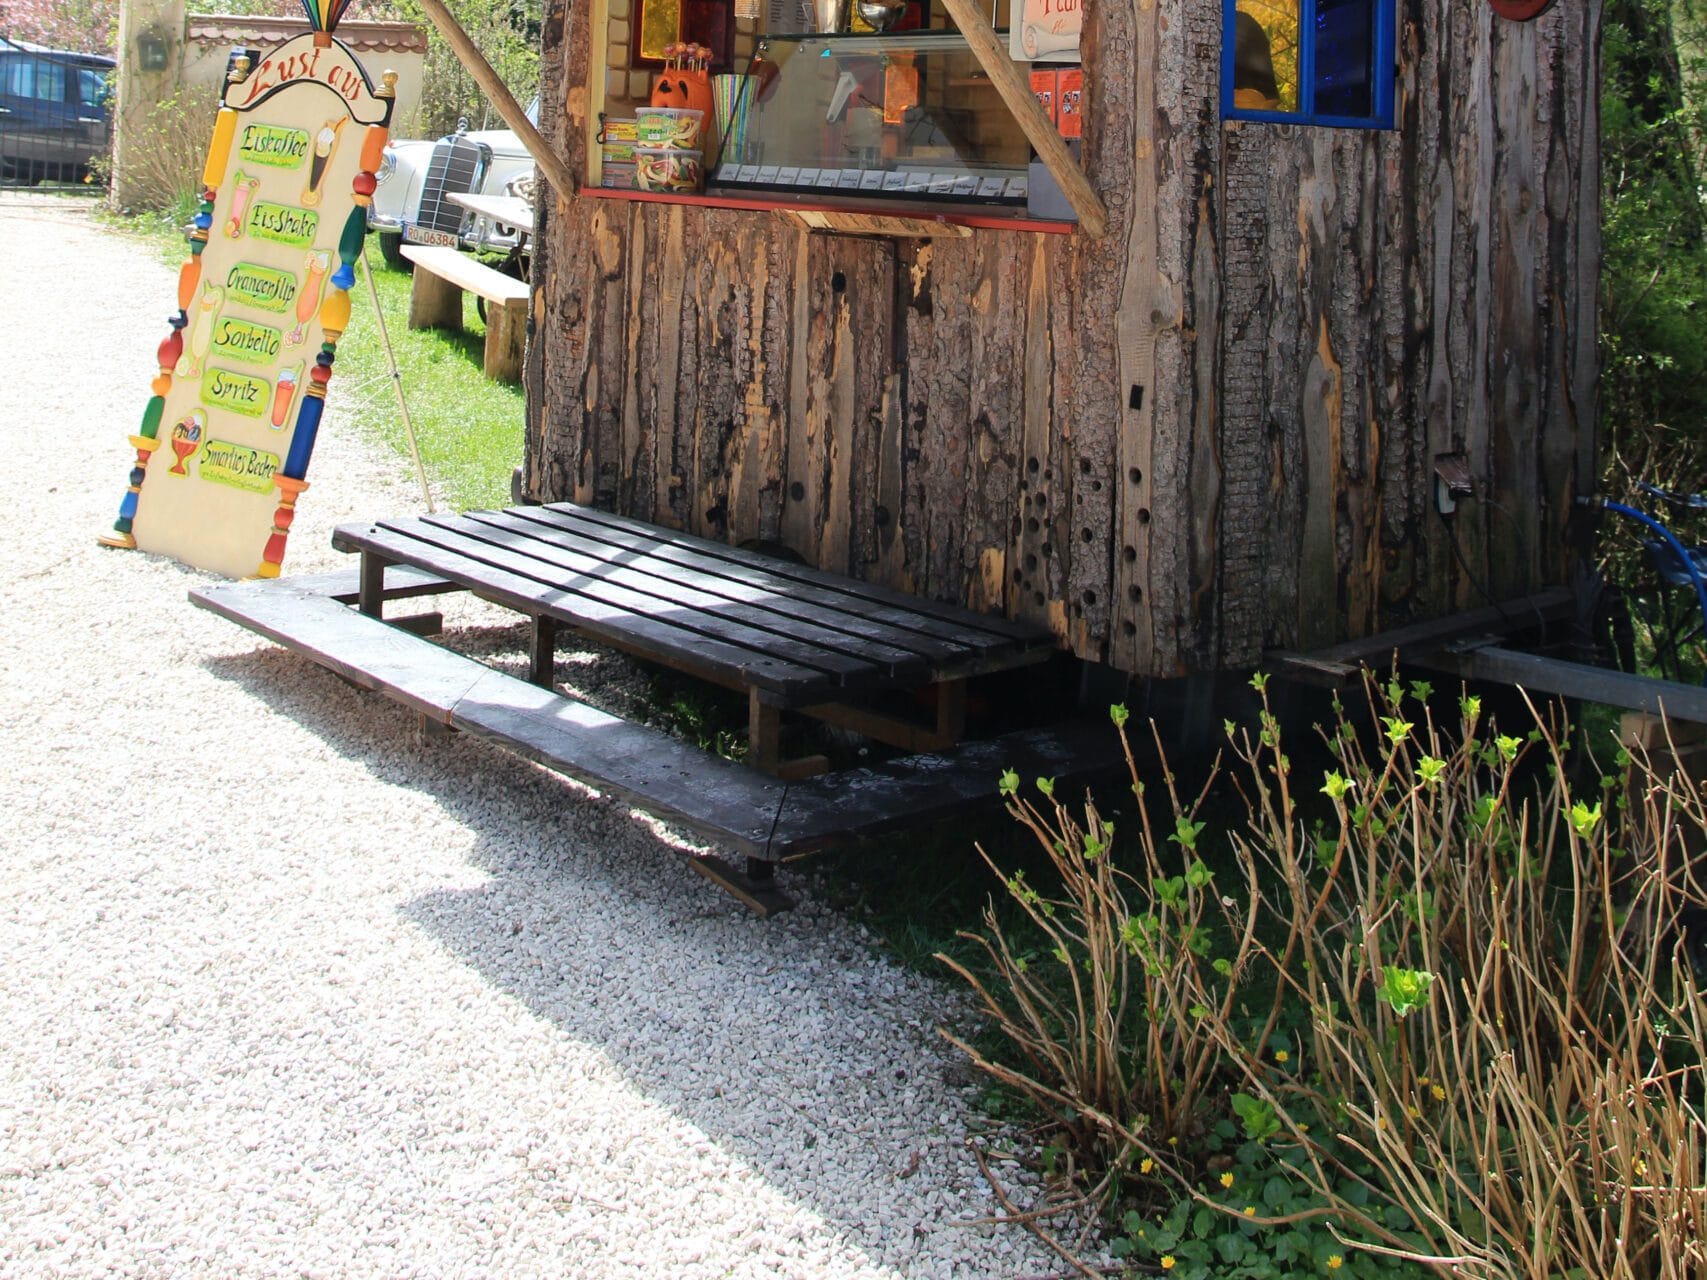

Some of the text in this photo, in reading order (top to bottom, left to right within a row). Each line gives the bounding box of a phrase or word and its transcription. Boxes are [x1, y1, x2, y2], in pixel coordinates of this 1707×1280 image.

[241, 48, 365, 106] Lust auf
[240, 125, 308, 158] Eiskaffee
[226, 267, 296, 308] Orangenflip
[211, 372, 259, 402] Spritz
